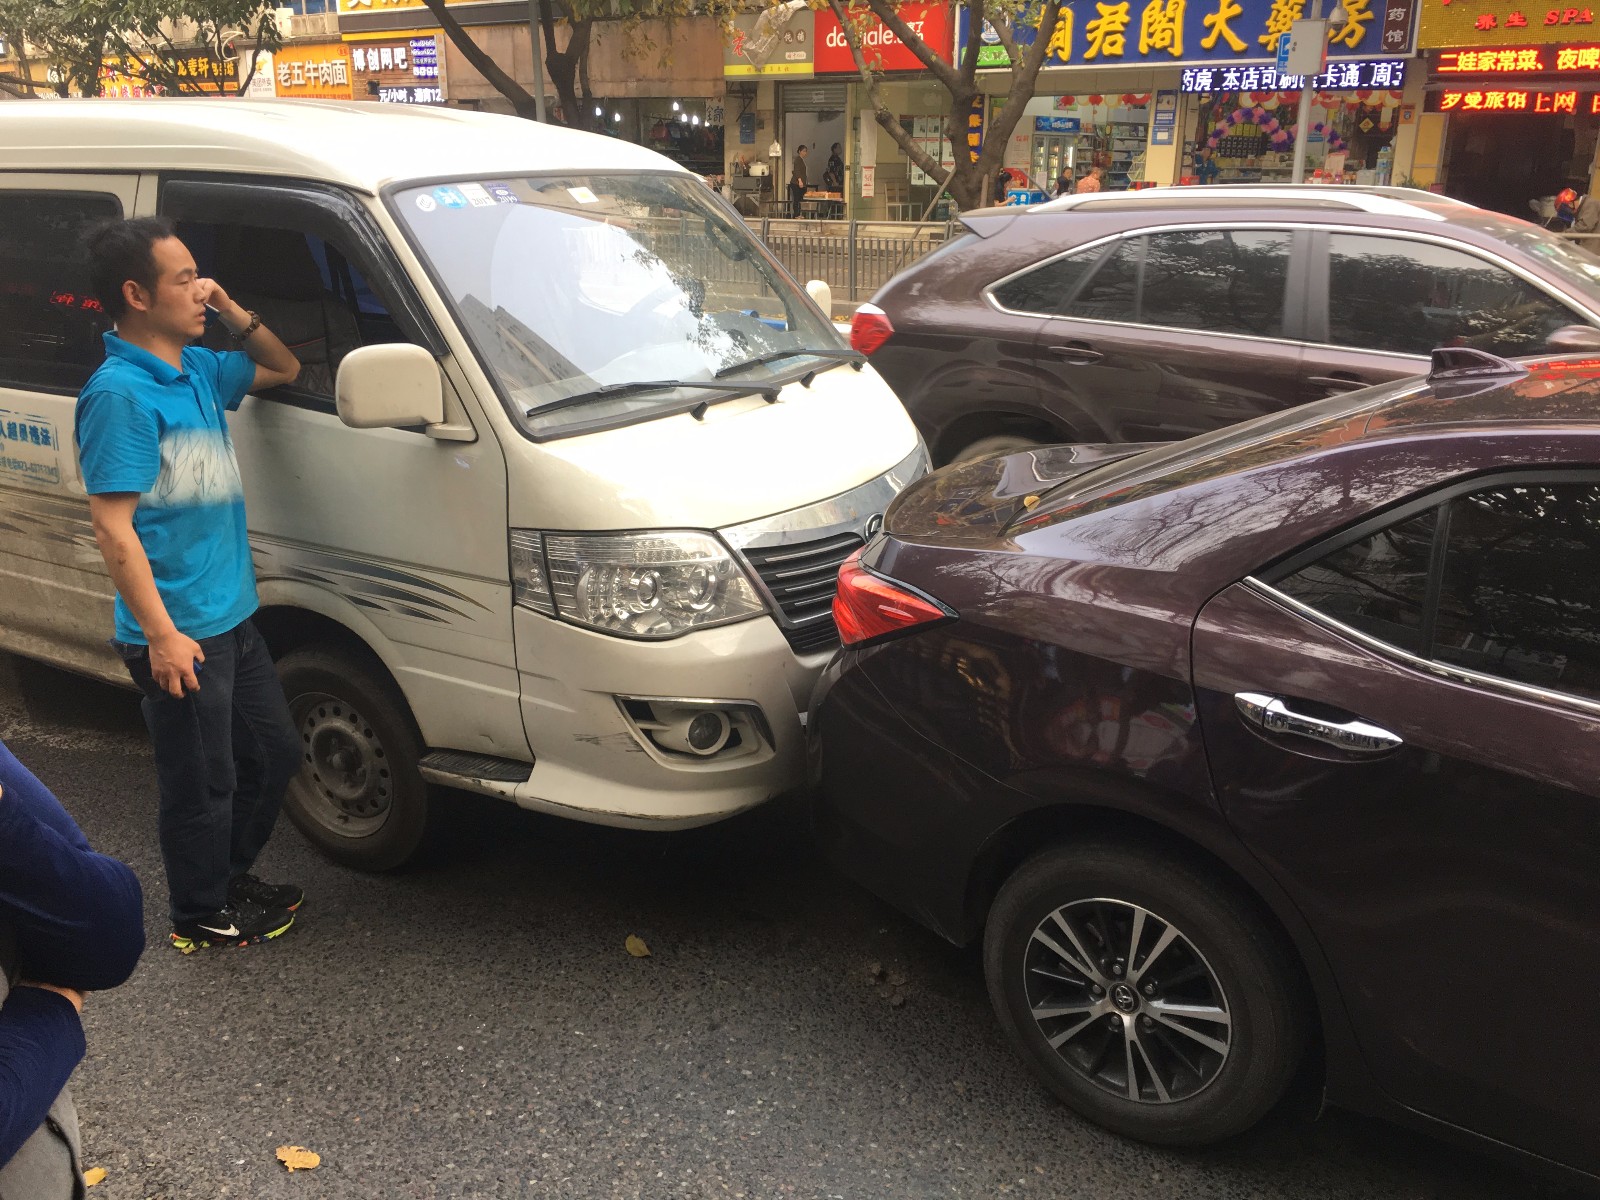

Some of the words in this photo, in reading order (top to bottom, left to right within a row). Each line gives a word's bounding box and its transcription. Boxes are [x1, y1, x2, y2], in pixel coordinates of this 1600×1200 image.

[1544, 8, 1594, 25] SPA
[277, 60, 348, 87] 老五牛肉面
[1441, 91, 1527, 110] 罗曼旅馆
[1534, 91, 1577, 113] 上网
